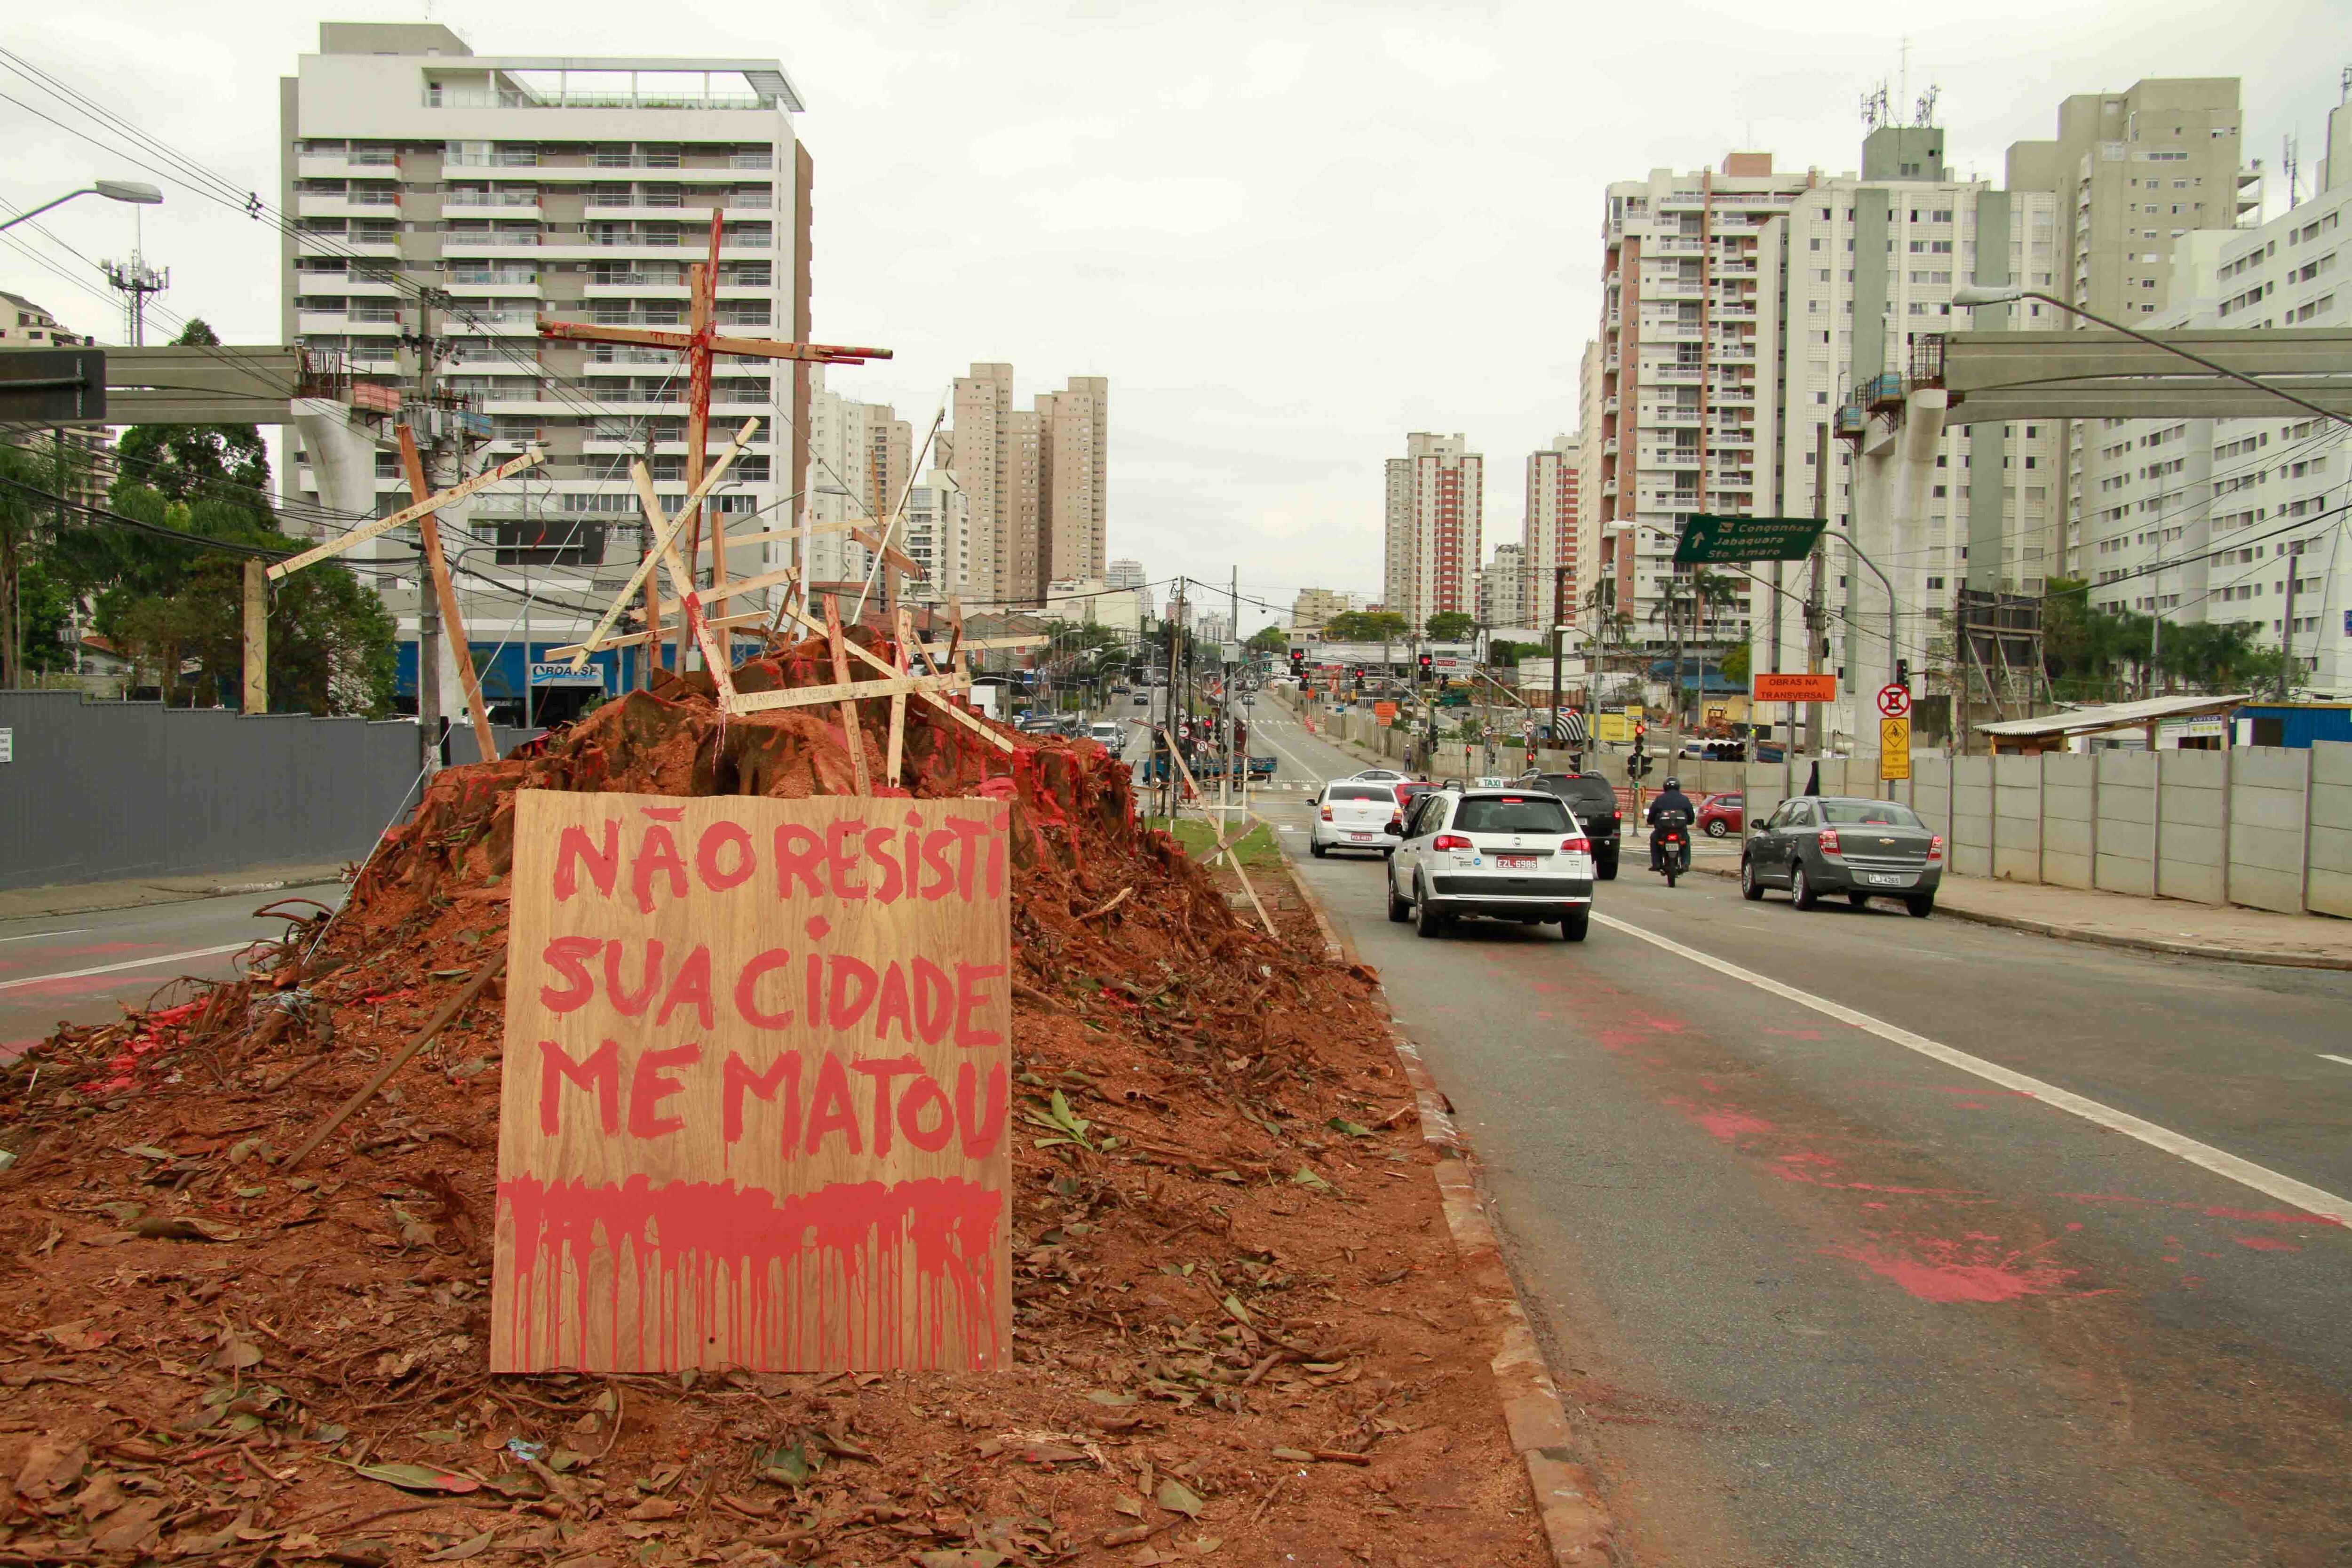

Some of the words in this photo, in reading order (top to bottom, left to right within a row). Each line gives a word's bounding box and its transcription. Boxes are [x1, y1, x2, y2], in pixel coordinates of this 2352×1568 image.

[1713, 536, 1785, 546] Jabaquara
[1736, 549, 1781, 557] Amaro
[1738, 523, 1814, 533] Congonhas
[554, 804, 757, 914] NÃO
[540, 936, 715, 1030] SUA
[734, 915, 1007, 1048] CIDADE
[539, 1039, 702, 1139] ME
[723, 1049, 1009, 1160] MATOU
